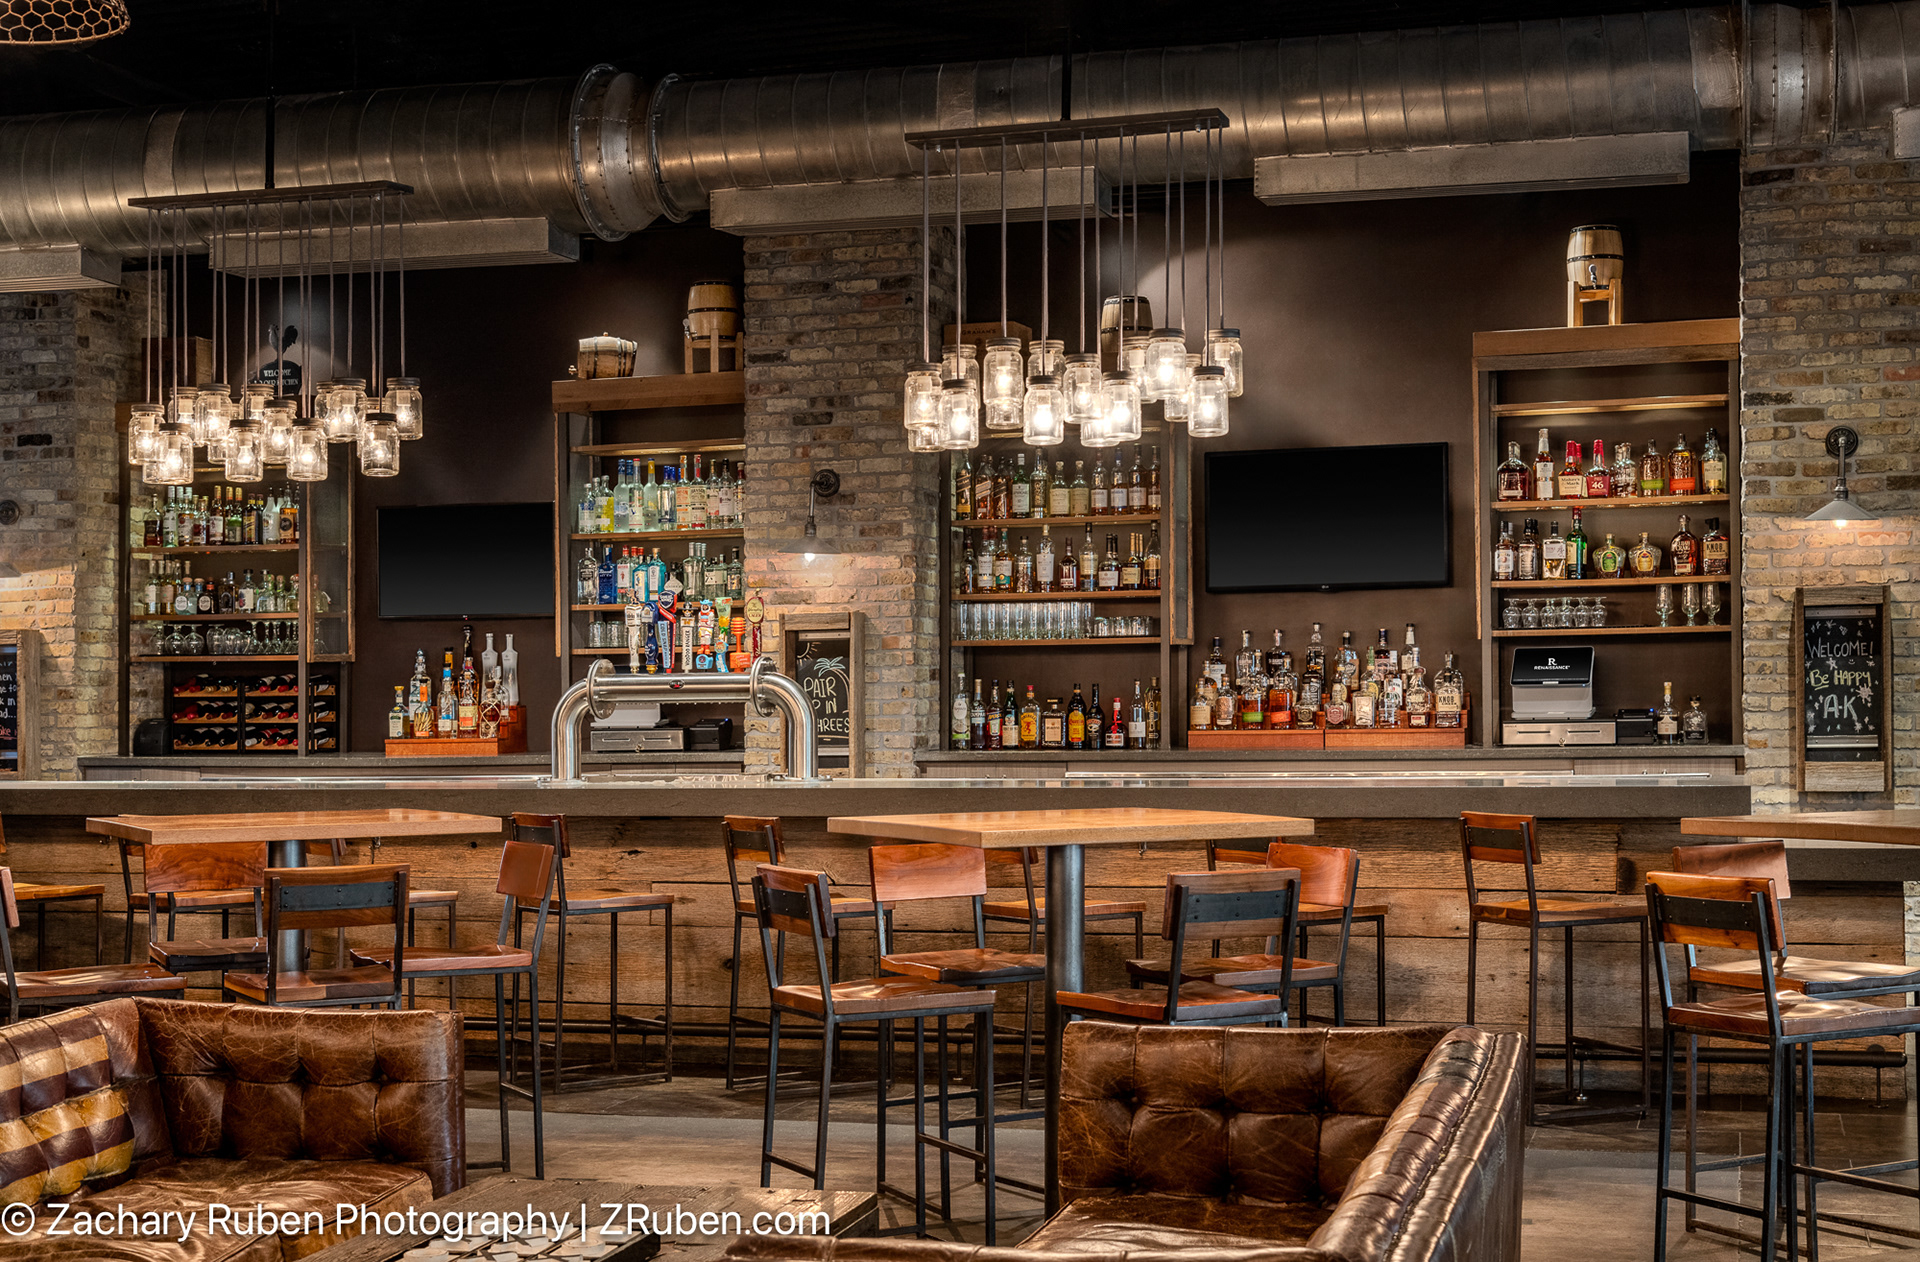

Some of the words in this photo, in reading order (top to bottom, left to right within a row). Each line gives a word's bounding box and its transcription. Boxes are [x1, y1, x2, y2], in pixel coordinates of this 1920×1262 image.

[263, 369, 292, 377] WELCME
[1806, 637, 1874, 659] WELCOME!
[1547, 657, 1557, 666] R
[1809, 669, 1830, 688] Be
[1833, 669, 1872, 687] HAPPY
[803, 676, 837, 698] PAIR
[825, 697, 838, 714] IN
[1438, 695, 1455, 703] KNOB
[817, 717, 850, 733] HREES
